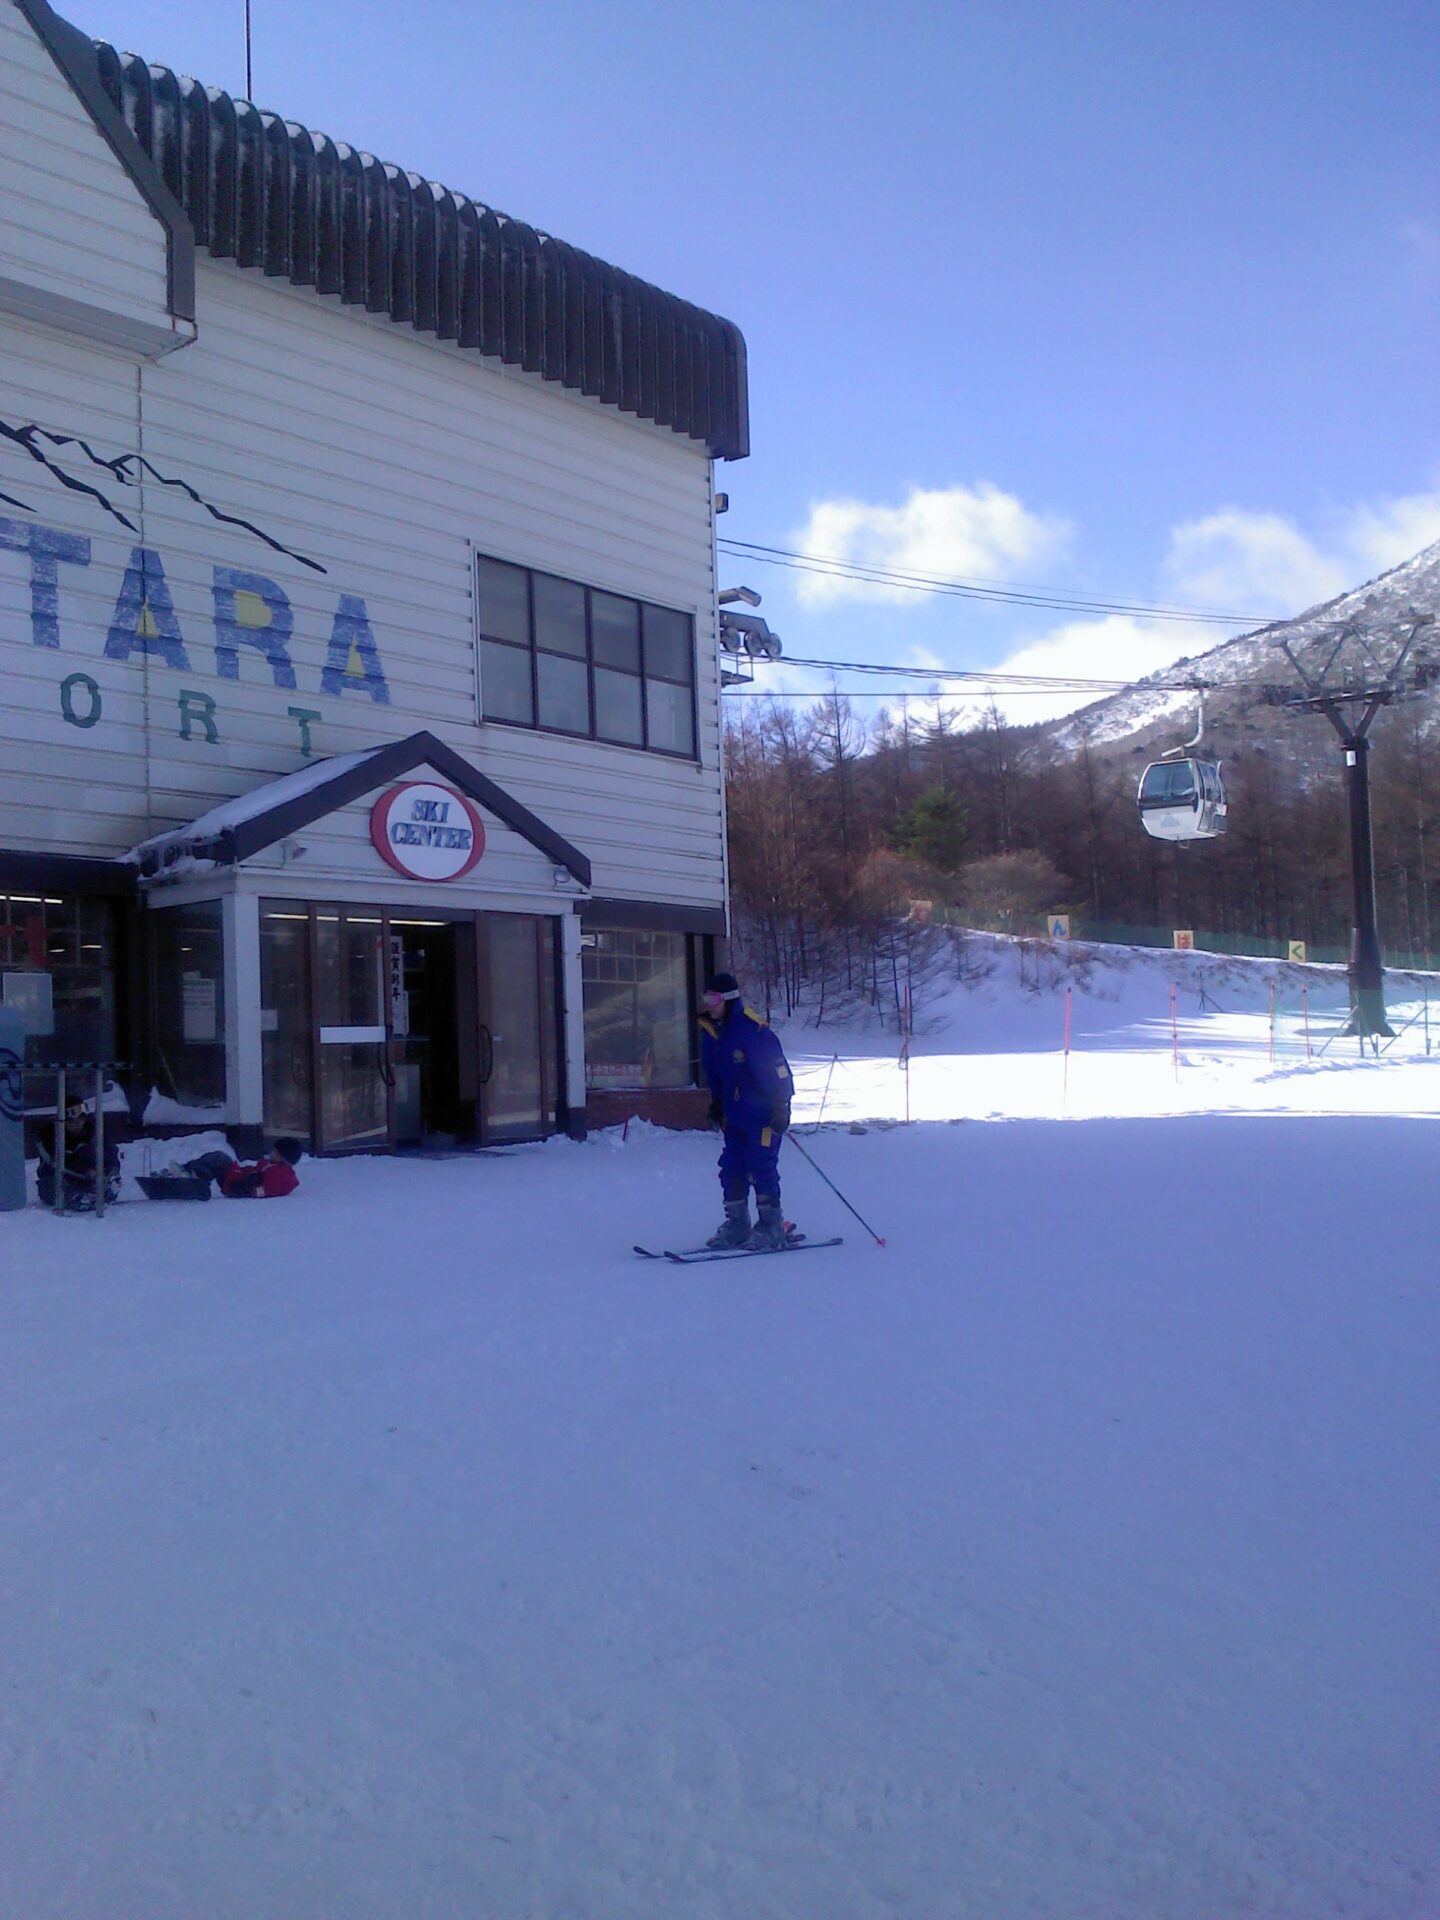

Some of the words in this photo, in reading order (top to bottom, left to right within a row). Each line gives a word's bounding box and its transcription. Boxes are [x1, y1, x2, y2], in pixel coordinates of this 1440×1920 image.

[0, 517, 390, 703] TARA
[411, 799, 450, 823] SKI
[391, 822, 472, 850] CENTER
